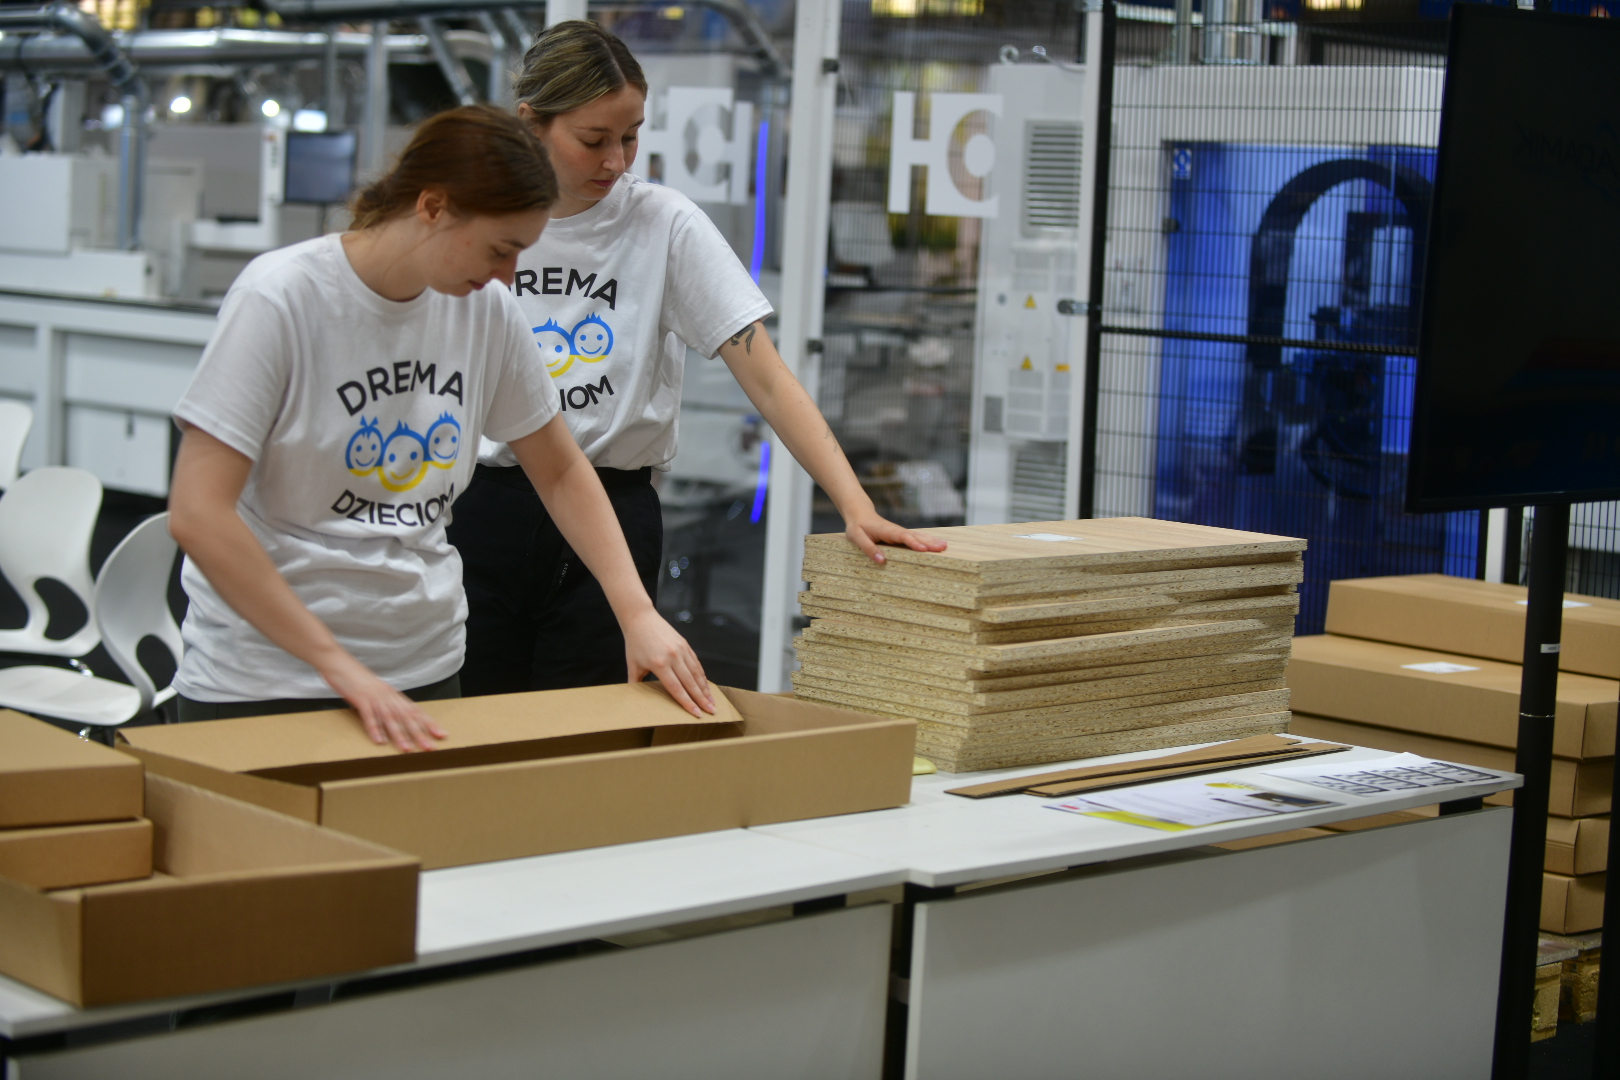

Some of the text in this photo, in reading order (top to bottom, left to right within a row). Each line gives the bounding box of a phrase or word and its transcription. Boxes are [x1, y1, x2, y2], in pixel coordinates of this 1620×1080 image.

[509, 267, 618, 311] REMA
[336, 360, 463, 417] DREMA
[331, 482, 454, 527] DZIECIOM
